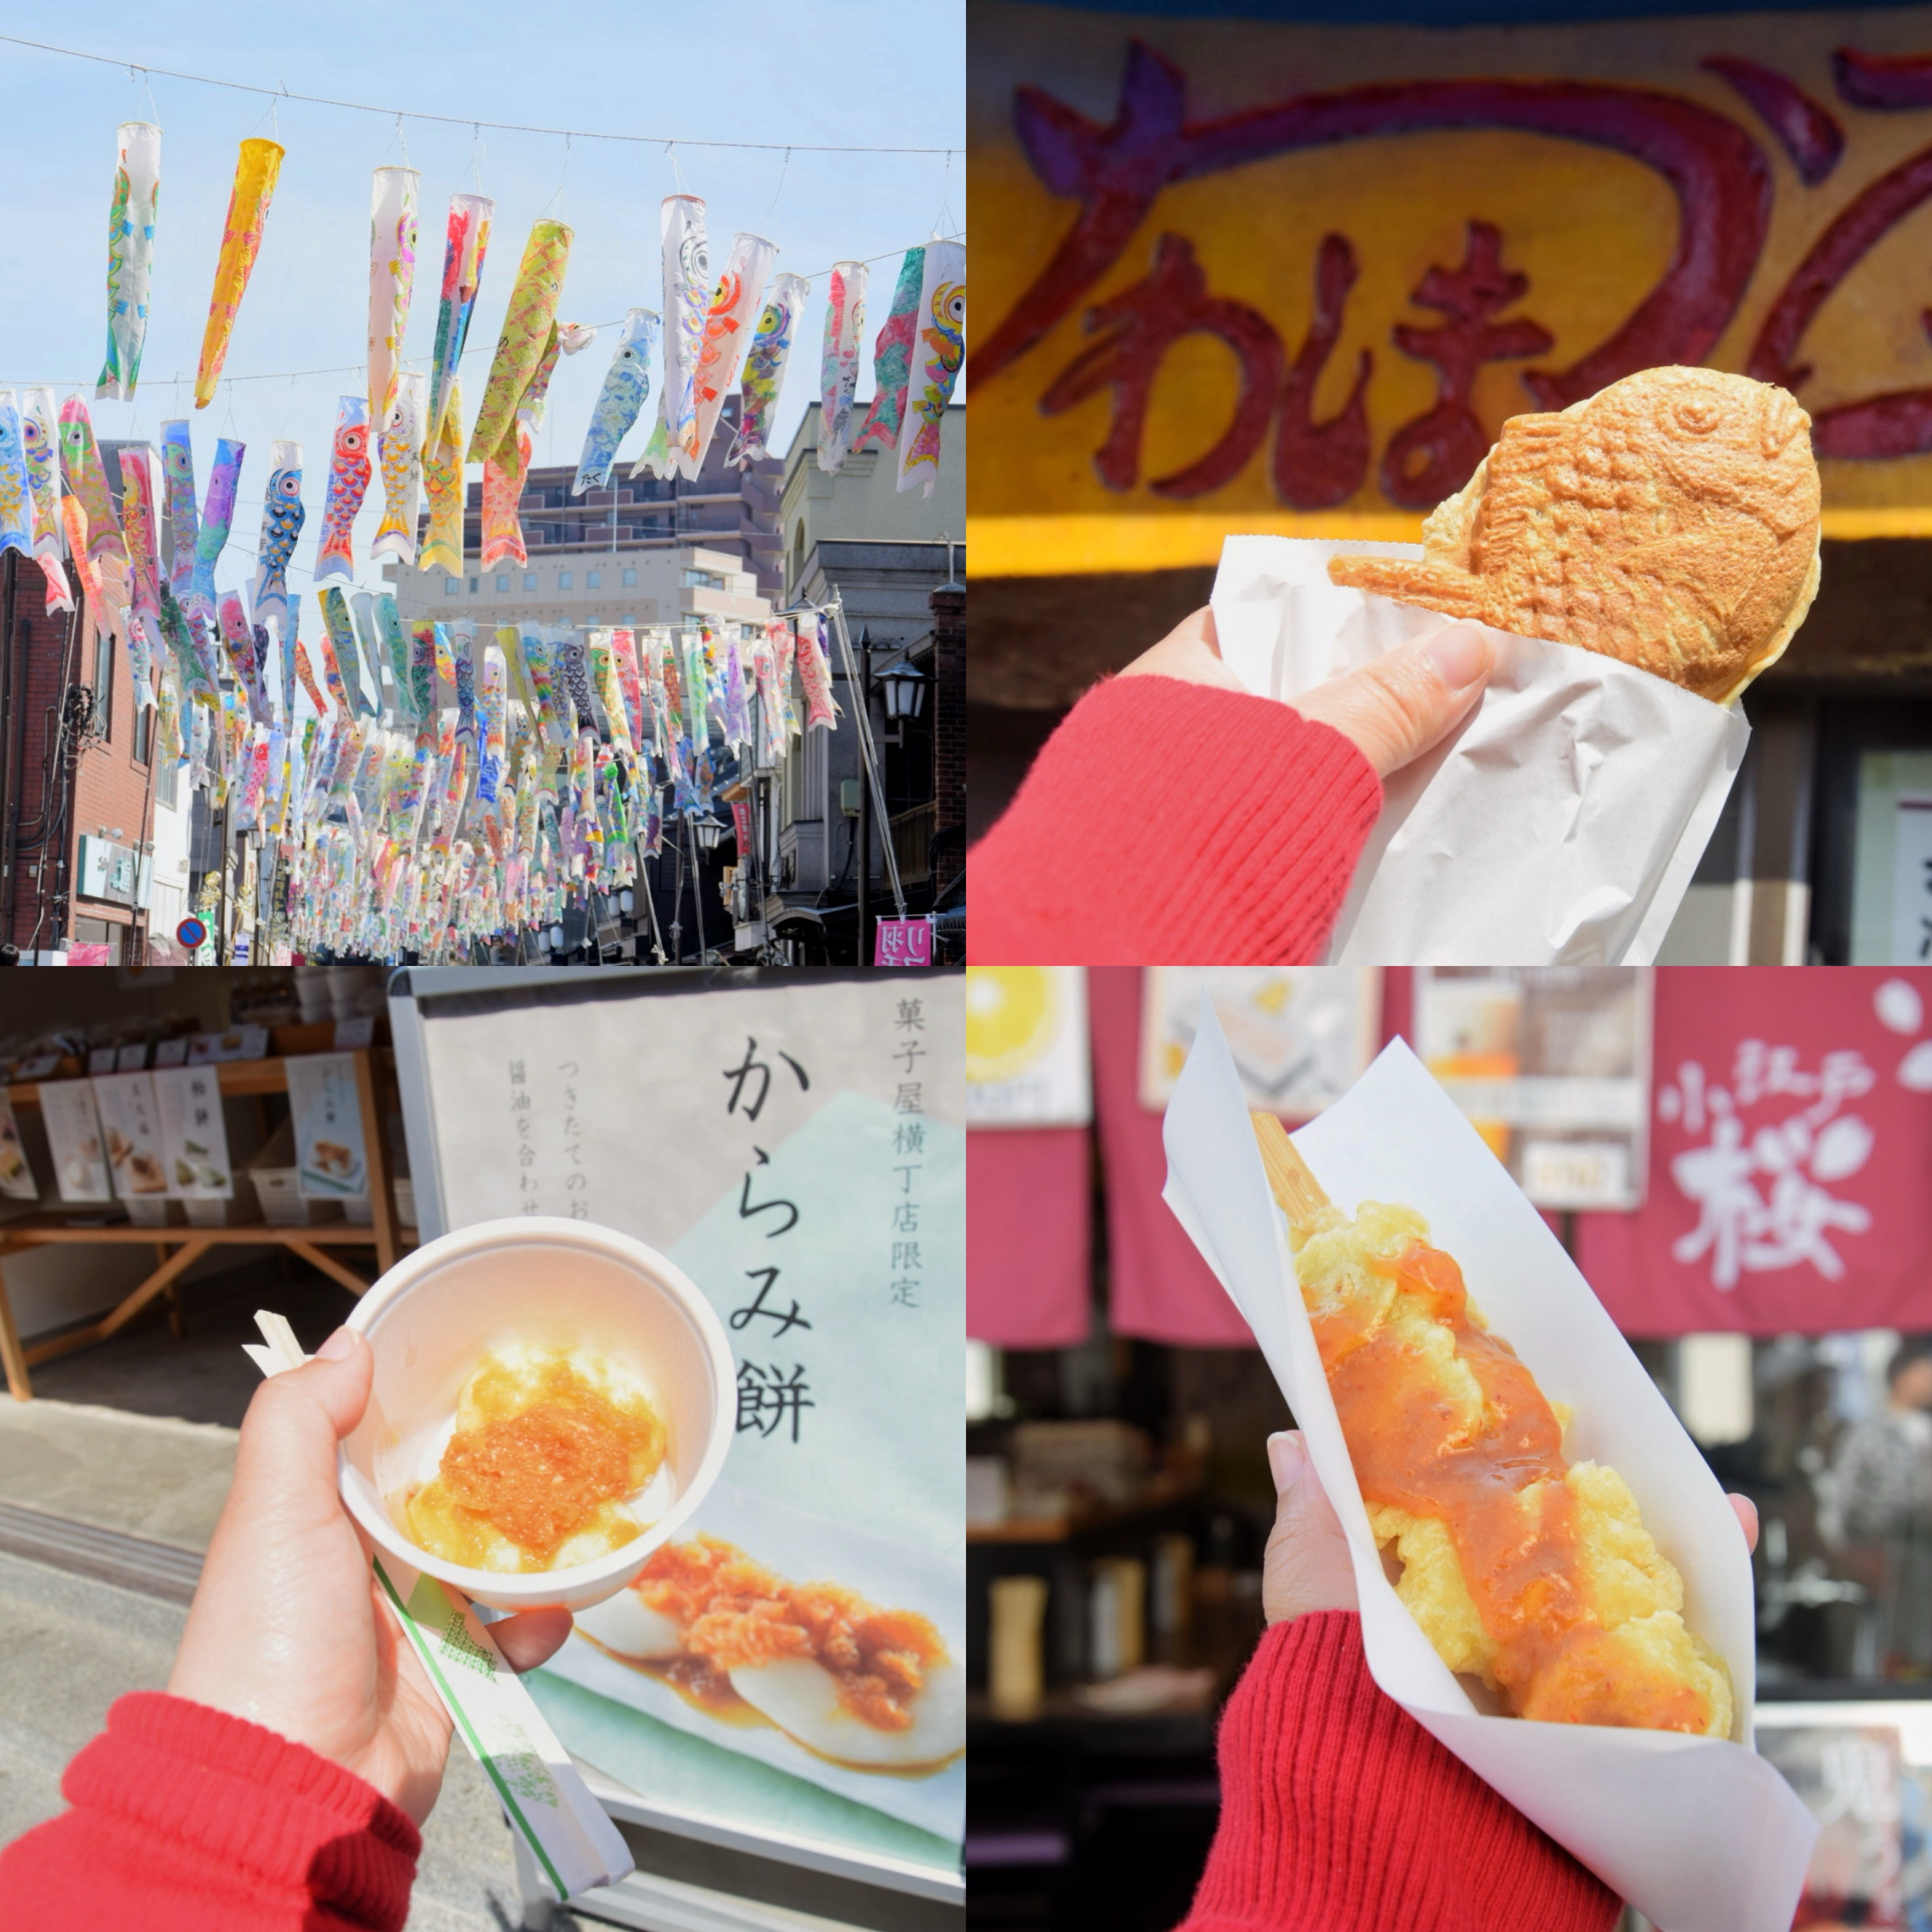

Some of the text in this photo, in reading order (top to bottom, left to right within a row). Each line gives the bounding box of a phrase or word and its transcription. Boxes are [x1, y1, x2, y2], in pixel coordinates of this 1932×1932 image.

[722, 1035, 816, 1444] からみ餅
[890, 997, 926, 1308] 菓子屋横丁店限定
